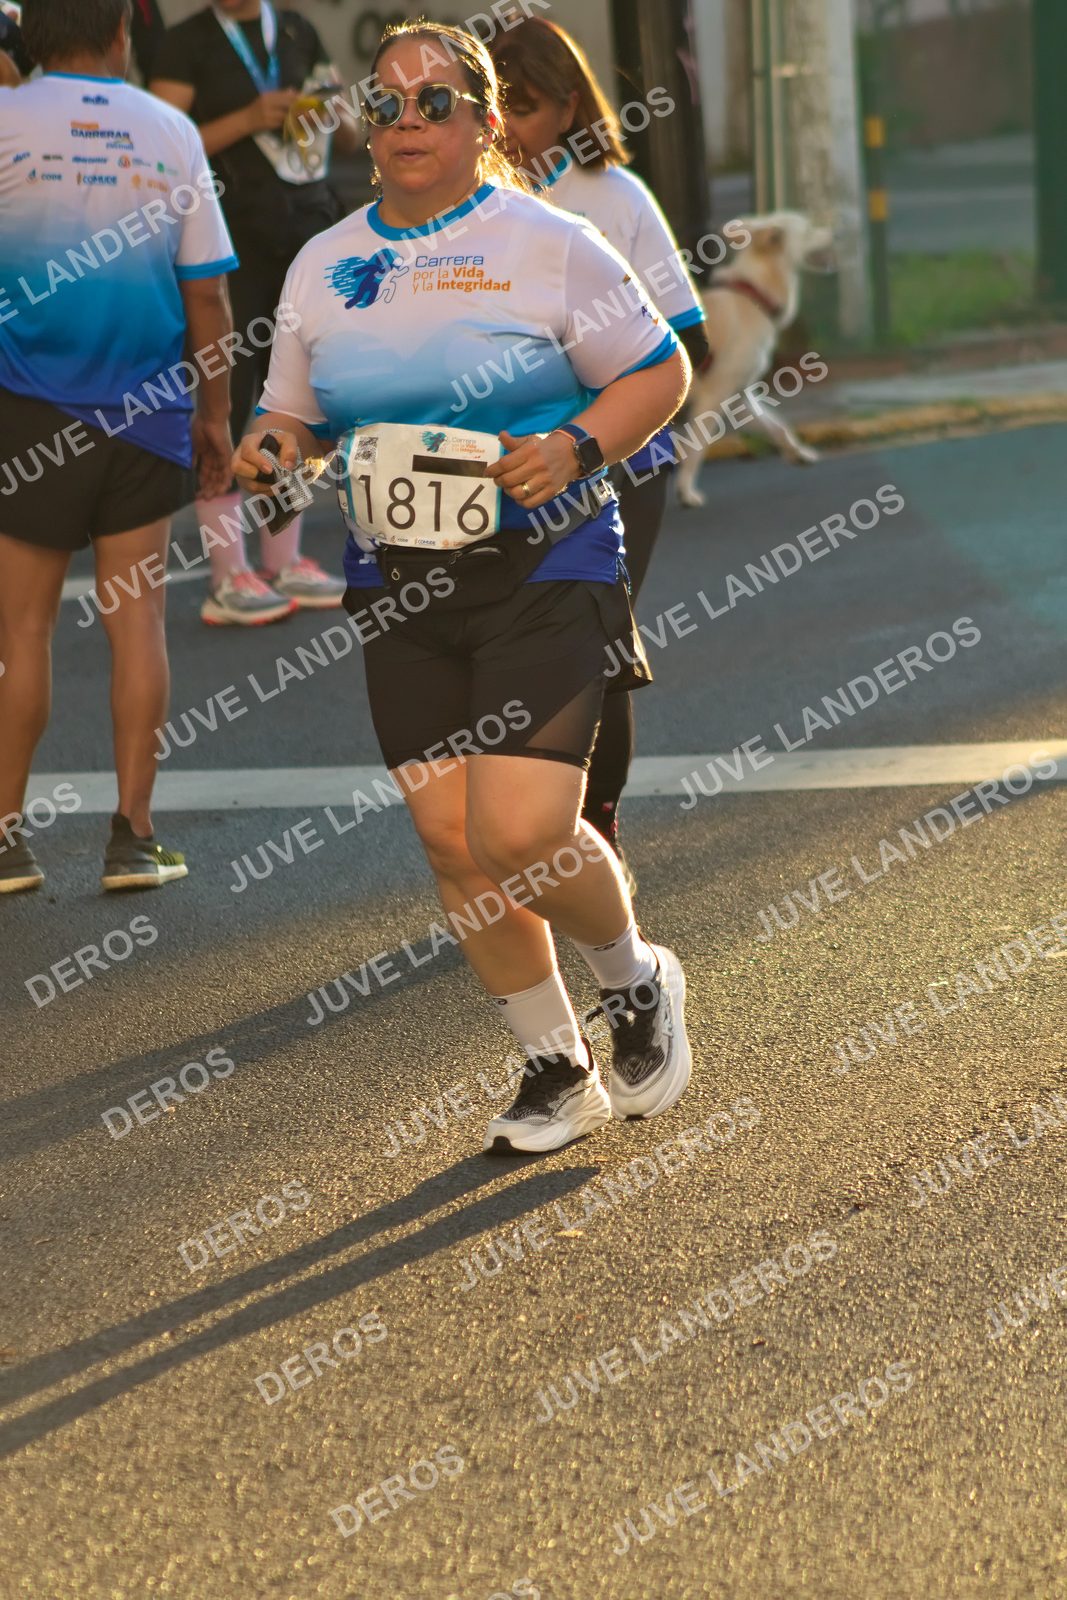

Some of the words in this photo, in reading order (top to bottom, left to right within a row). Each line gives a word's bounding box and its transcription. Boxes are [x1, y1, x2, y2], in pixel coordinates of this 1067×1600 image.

[416, 256, 484, 268] Carrera
[414, 271, 434, 282] por
[438, 269, 448, 278] la
[453, 266, 484, 278] Vida
[412, 284, 419, 294] y
[422, 280, 432, 291] la
[437, 278, 511, 292] Integridad
[358, 474, 489, 536] 1816
